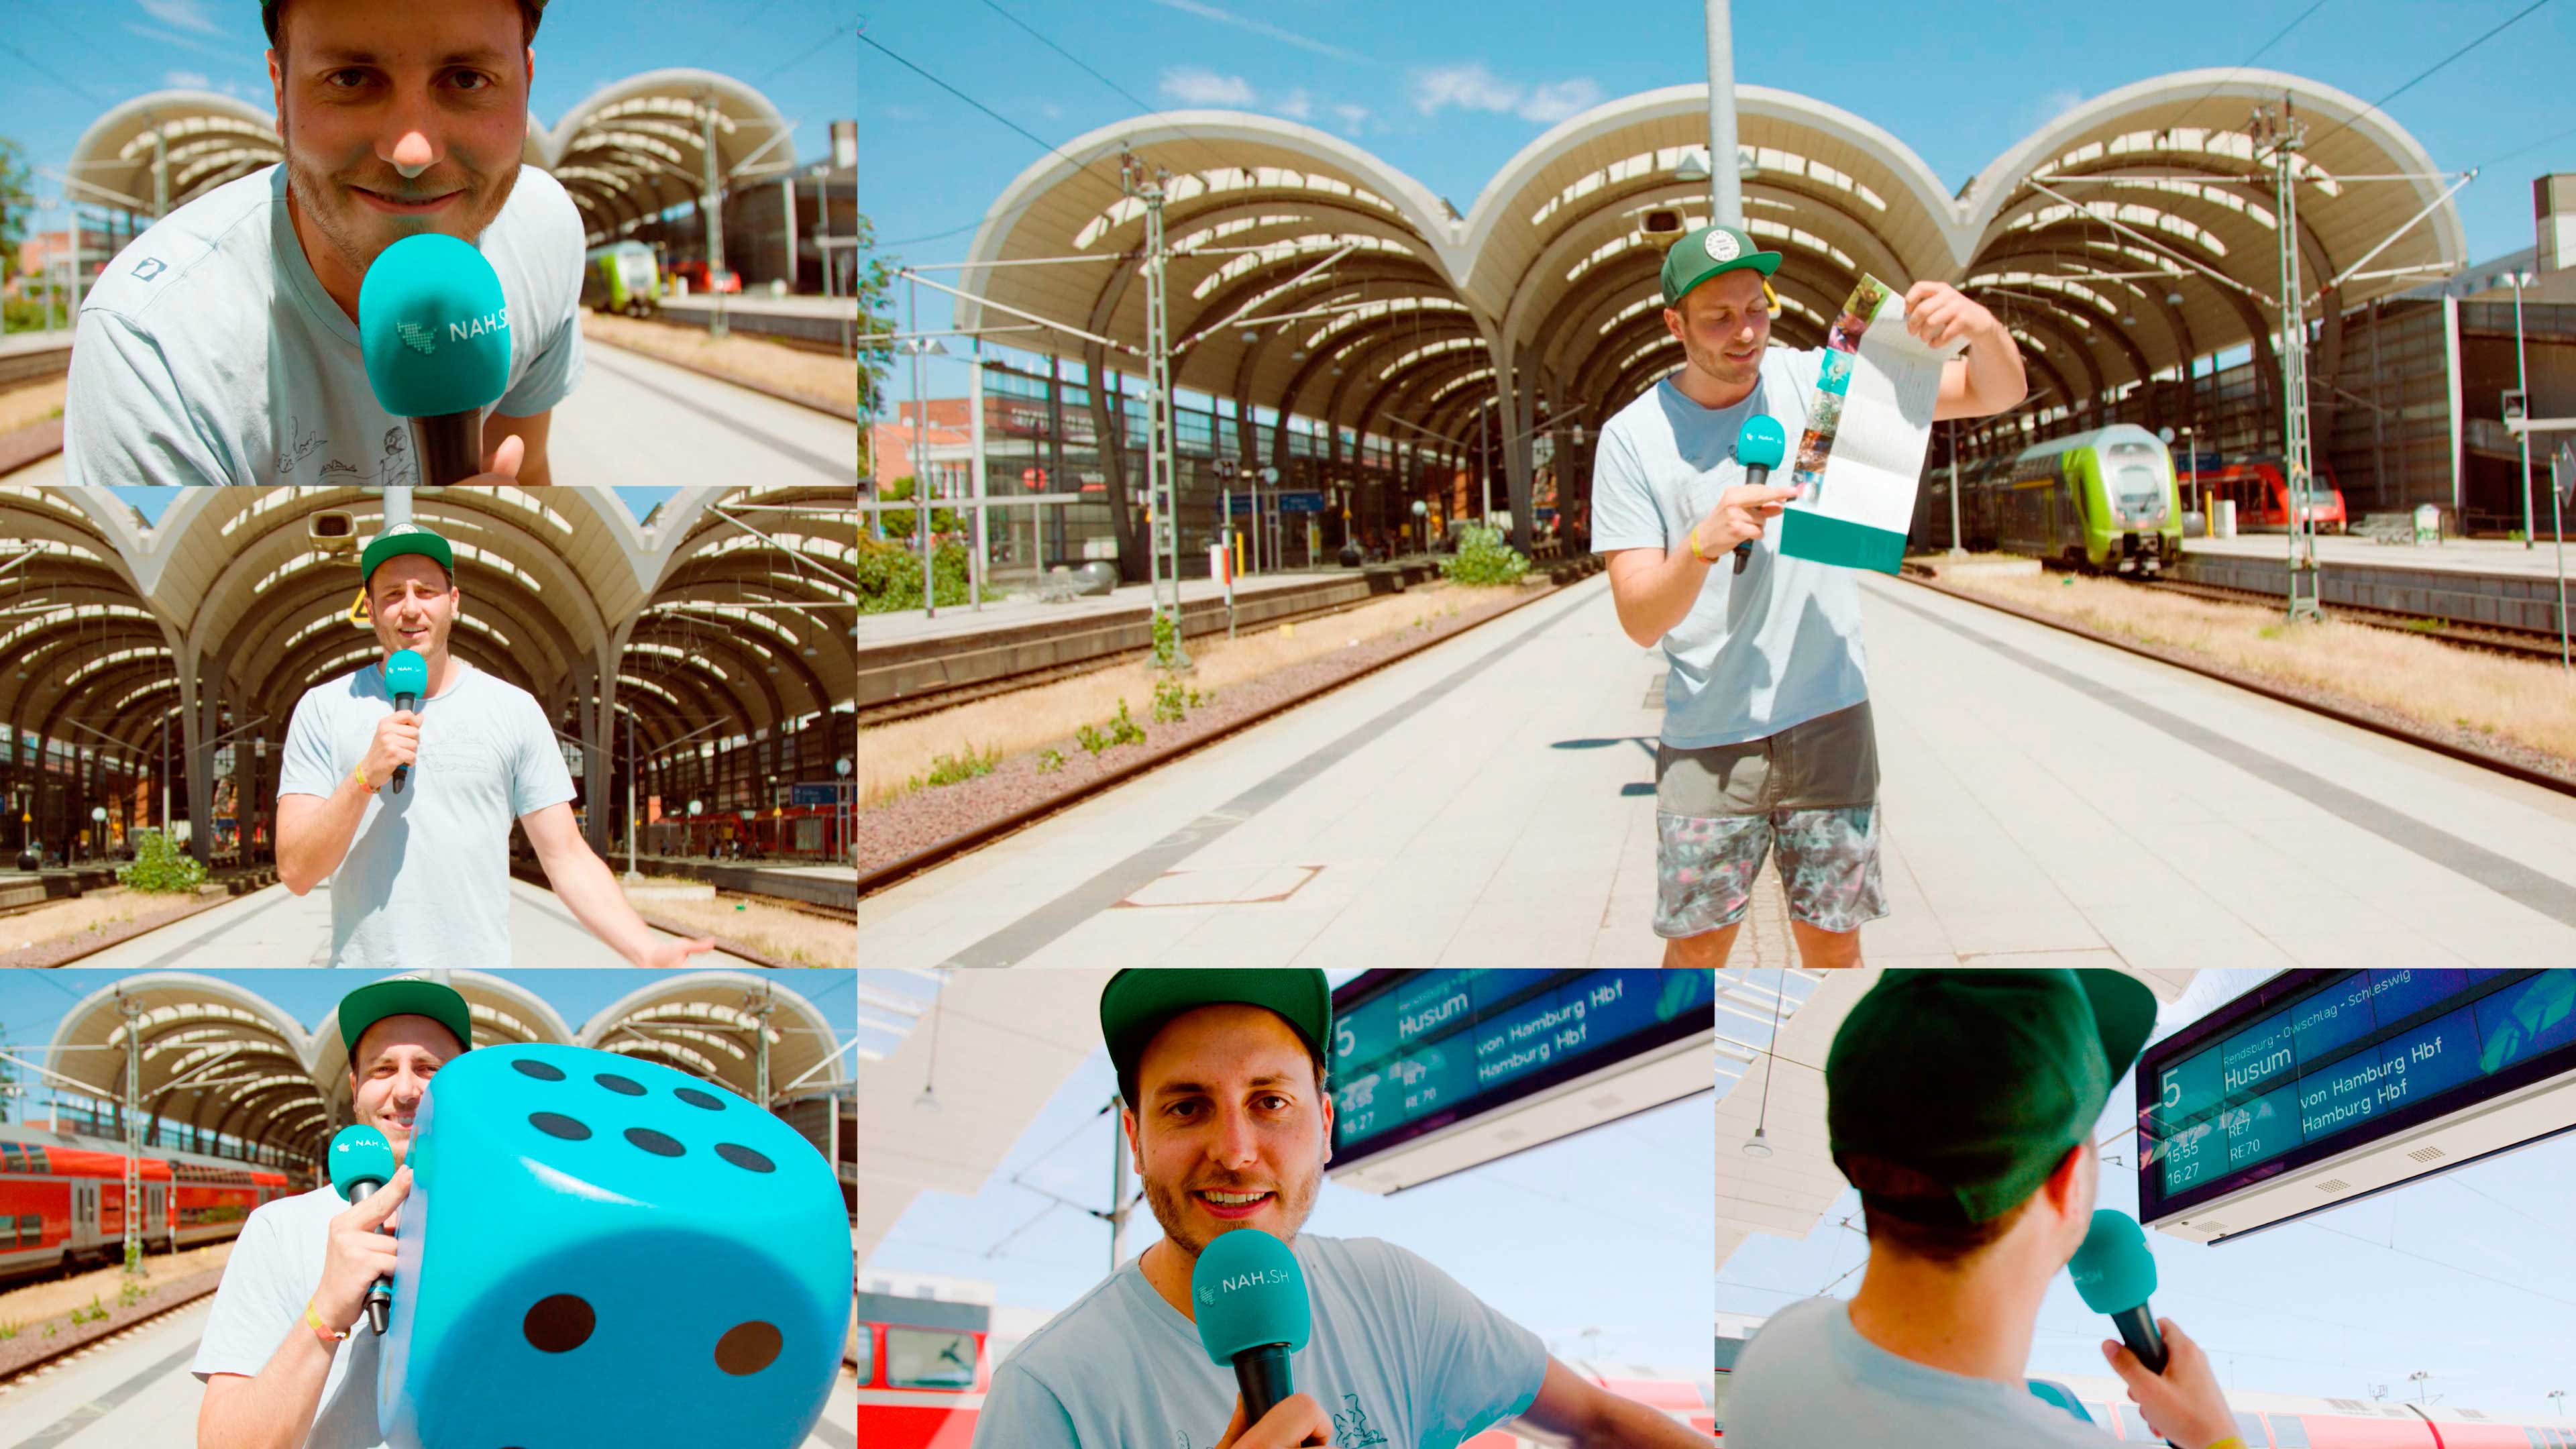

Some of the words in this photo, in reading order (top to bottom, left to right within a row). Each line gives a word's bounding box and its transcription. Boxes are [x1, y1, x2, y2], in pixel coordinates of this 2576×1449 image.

[1336, 1016, 1355, 1057] 5
[1399, 993, 1468, 1039] Husum
[1477, 1036, 1504, 1055] von
[1510, 1000, 1585, 1040] Hamburg
[1590, 978, 1623, 1009] Hbf
[2224, 1036, 2273, 1068] Rendsburg
[2284, 1006, 2338, 1038] Owschlag
[2348, 969, 2411, 1007] Schleswig
[1480, 1042, 1550, 1081] Hamburg
[1556, 1021, 1587, 1051] Hbf
[2224, 1049, 2291, 1091] Husum
[2163, 1069, 2180, 1108] 5
[2166, 1141, 2199, 1165] 15:55
[2229, 1118, 2250, 1138] RE7
[2300, 1090, 2326, 1109] von
[2333, 1055, 2406, 1097] Hamburg
[2411, 1036, 2442, 1063] Hbf
[2167, 1162, 2199, 1187] 16:27
[2230, 1138, 2260, 1161] RE70
[2302, 1097, 2371, 1134] Hamburg
[2377, 1078, 2408, 1104] Hbf
[1222, 1269, 1290, 1293] NAH.SH
